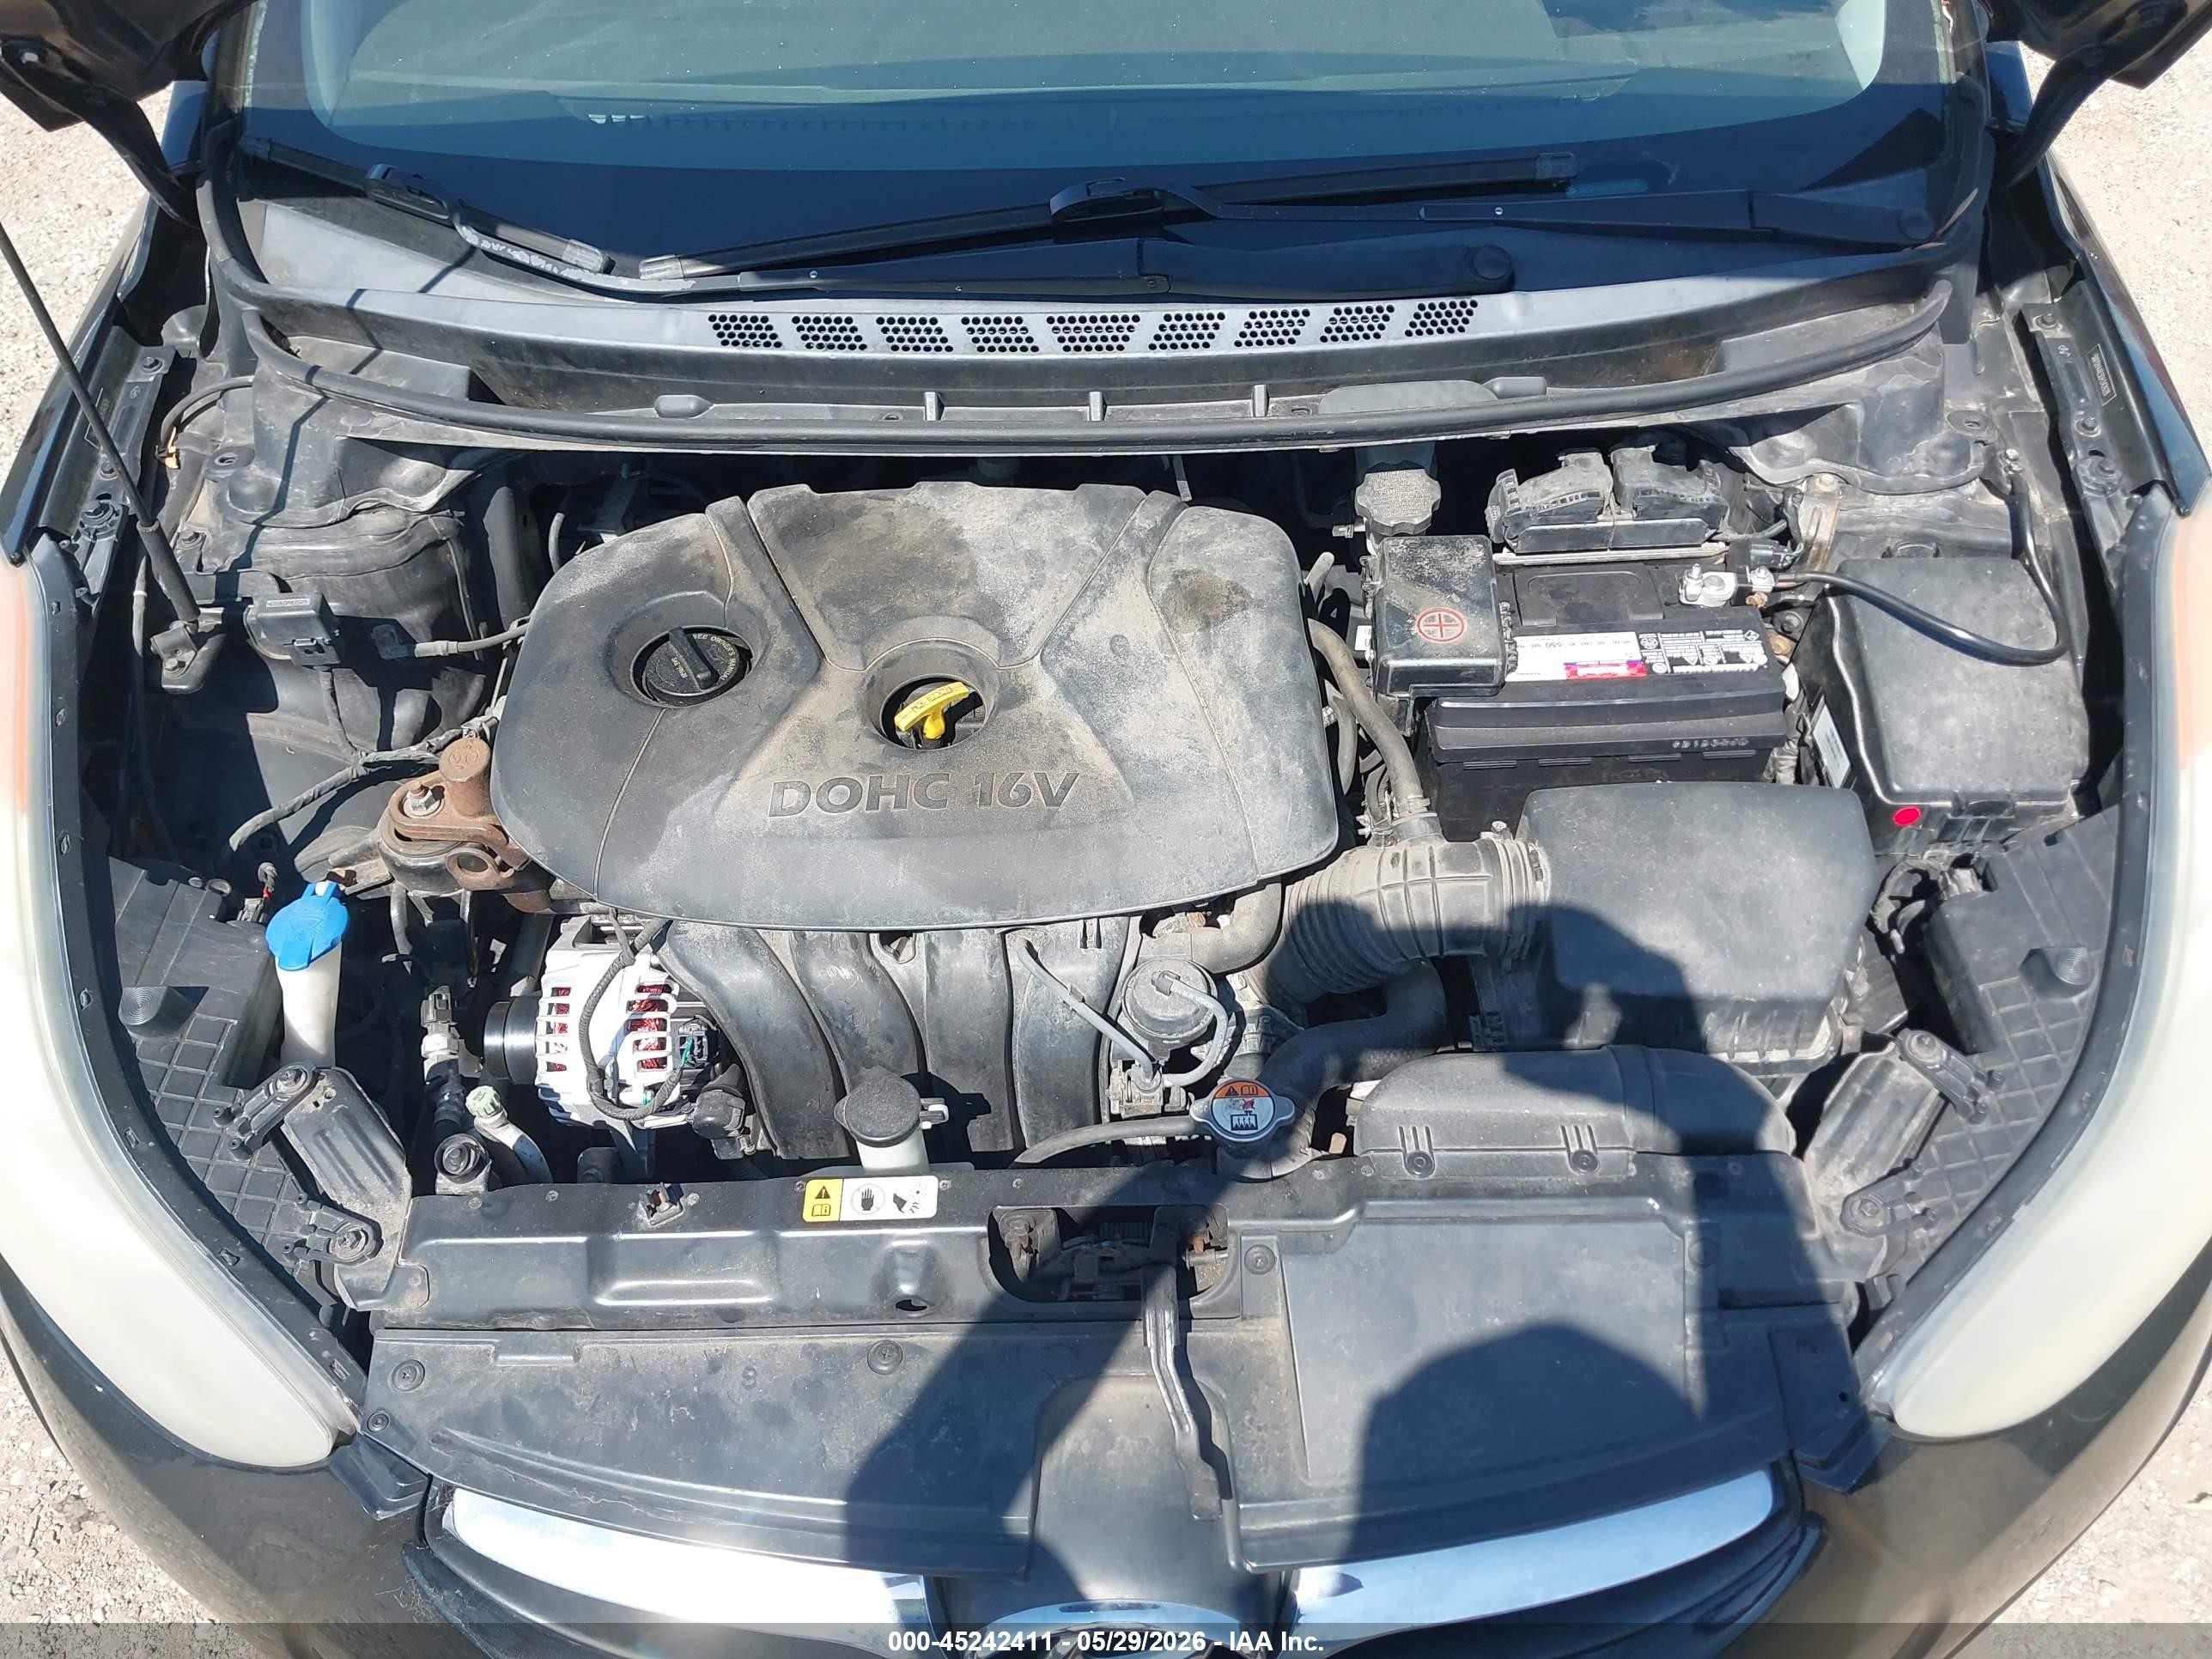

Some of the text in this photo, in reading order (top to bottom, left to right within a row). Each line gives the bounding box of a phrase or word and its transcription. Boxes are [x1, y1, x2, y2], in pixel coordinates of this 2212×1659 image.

[710, 635, 736, 656] OWNER'S
[769, 771, 1079, 817] DOHC 16V
